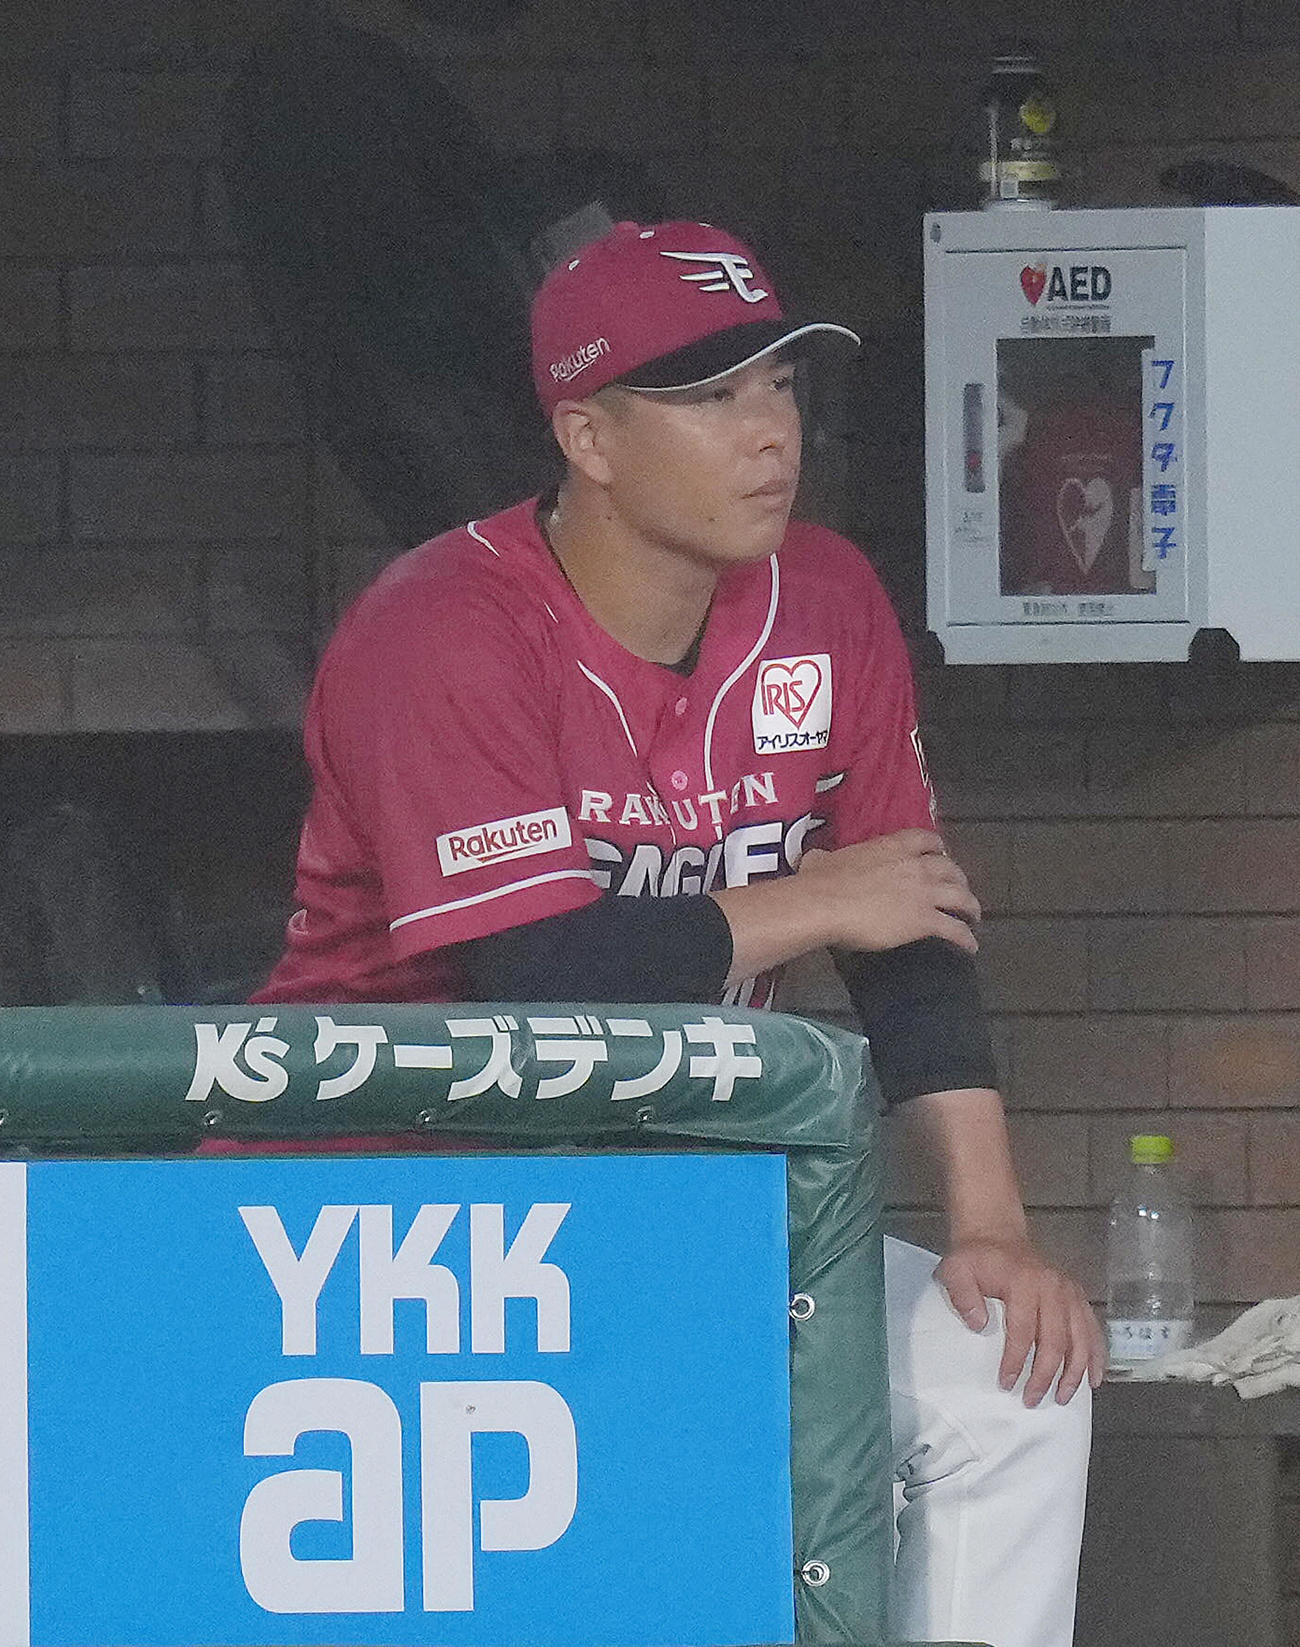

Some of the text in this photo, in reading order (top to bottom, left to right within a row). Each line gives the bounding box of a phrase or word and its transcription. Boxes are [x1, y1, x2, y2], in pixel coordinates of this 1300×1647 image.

[1047, 266, 1112, 301] AED
[550, 337, 612, 382] Rakuten
[1150, 360, 1177, 560] フクダ電子
[761, 680, 805, 716] IRIS
[448, 818, 558, 862] Rakuten
[186, 1015, 763, 1102] K's ケーズデンキ
[238, 1202, 572, 1357] YKK
[238, 1378, 579, 1615] ap
